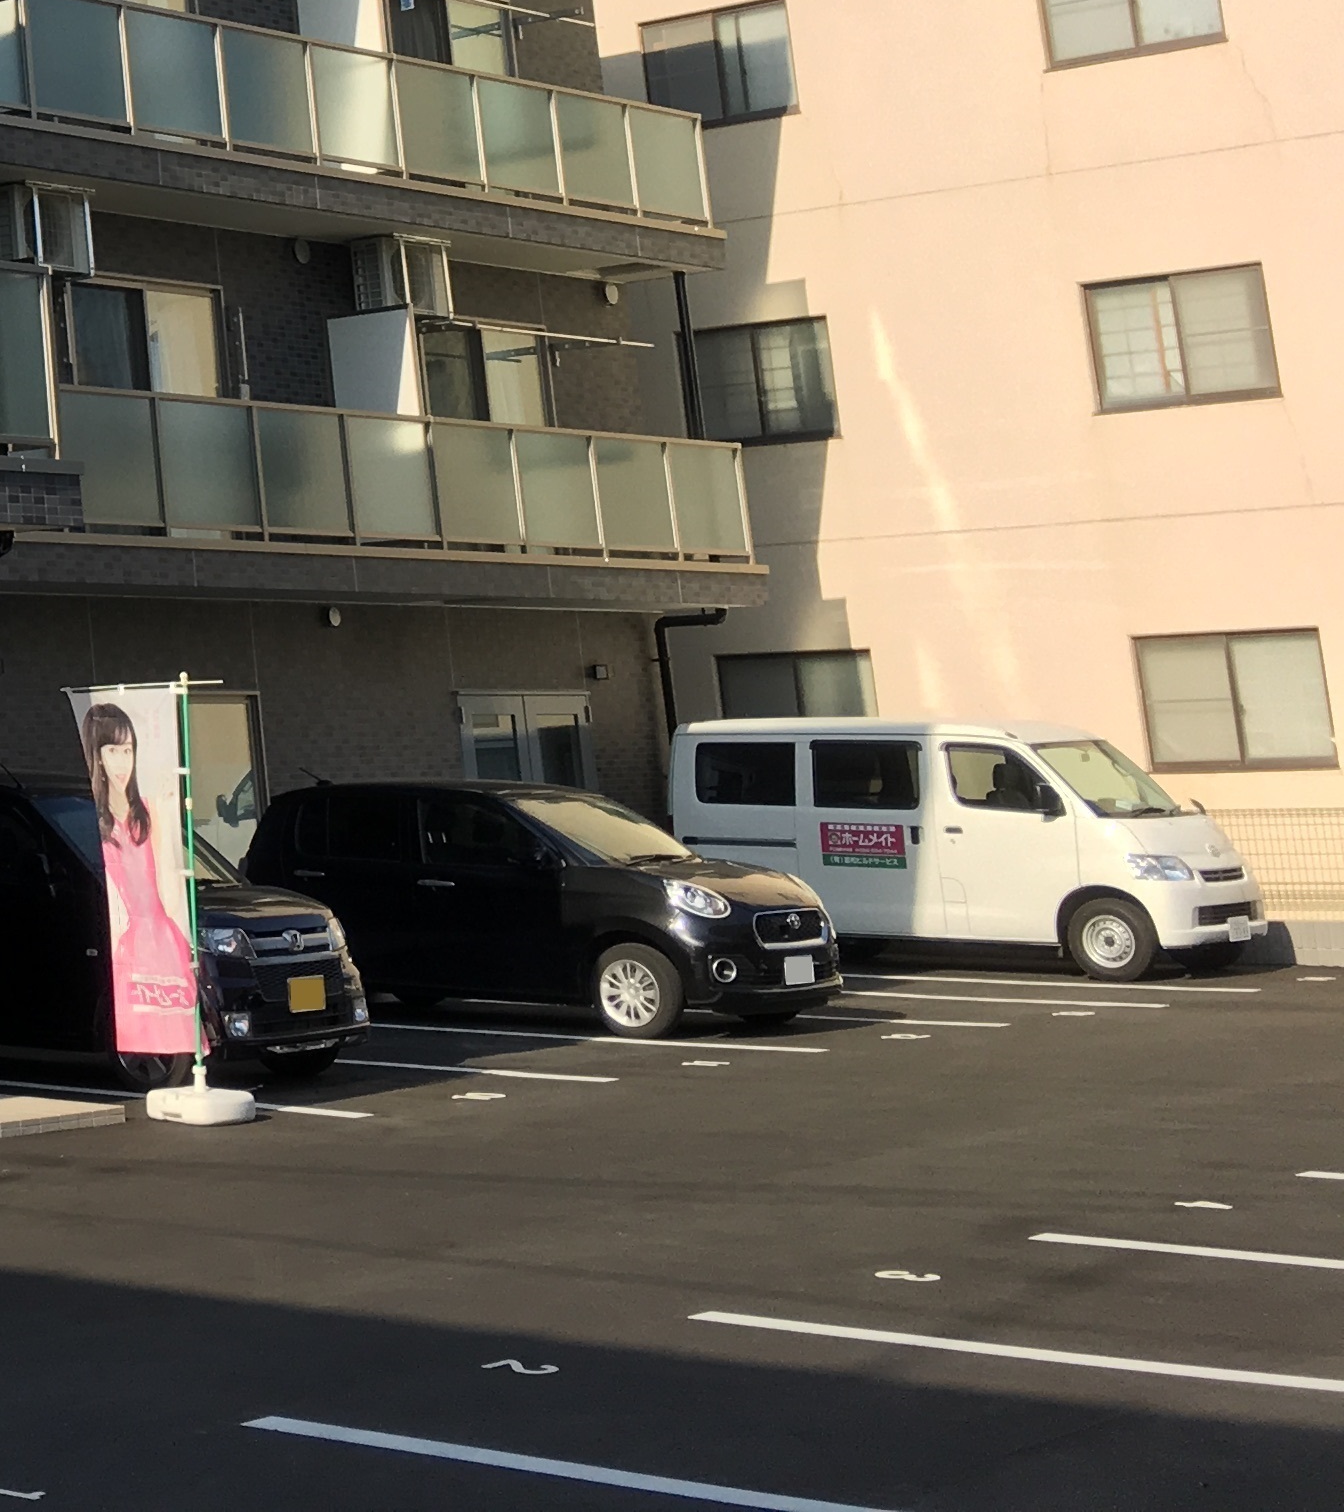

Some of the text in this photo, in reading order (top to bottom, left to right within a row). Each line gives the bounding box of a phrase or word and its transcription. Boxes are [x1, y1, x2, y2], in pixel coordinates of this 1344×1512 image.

[842, 832, 897, 846] ホームメイト
[481, 1359, 560, 1375] 2
